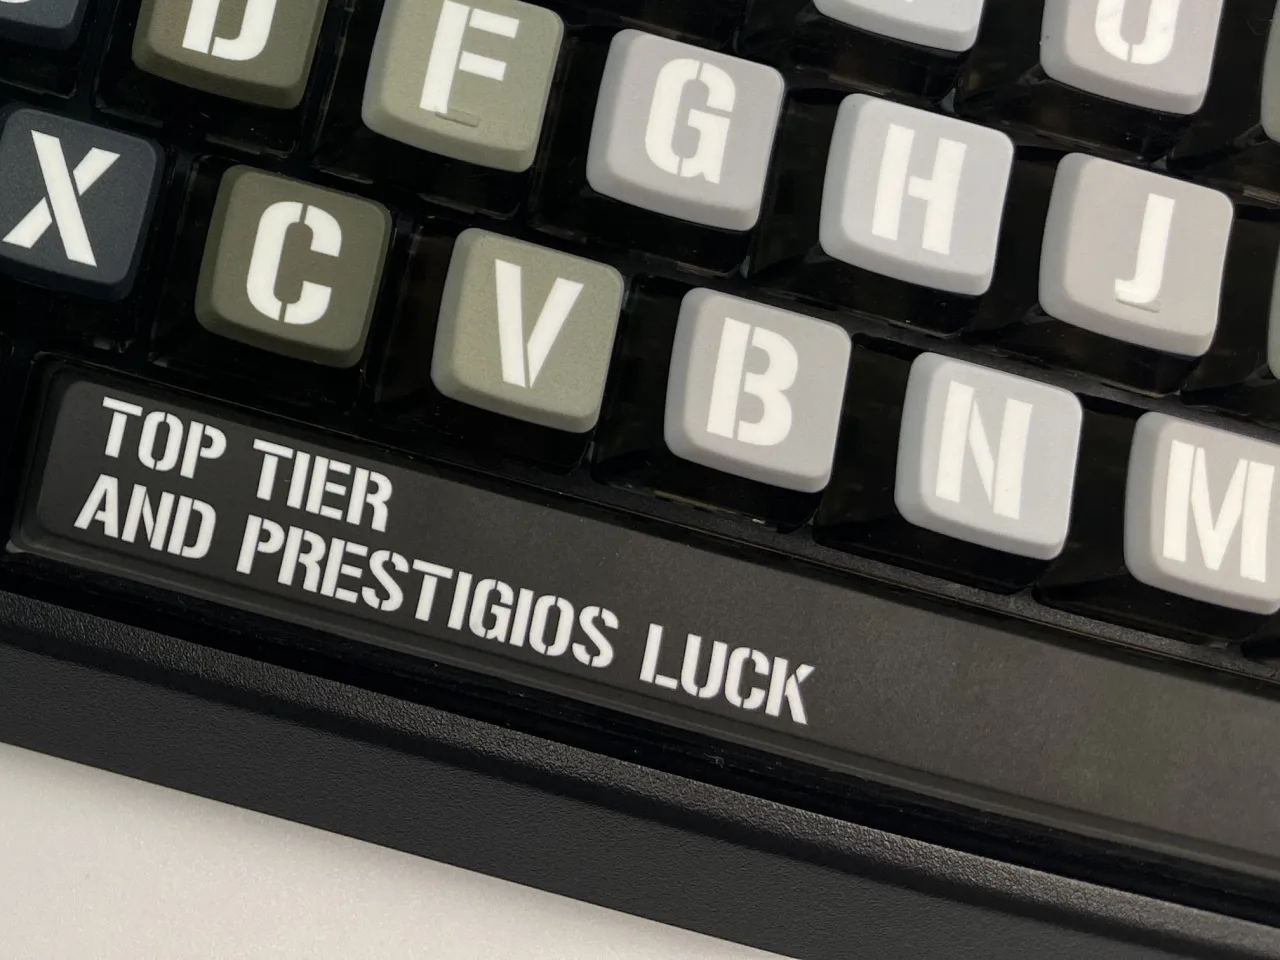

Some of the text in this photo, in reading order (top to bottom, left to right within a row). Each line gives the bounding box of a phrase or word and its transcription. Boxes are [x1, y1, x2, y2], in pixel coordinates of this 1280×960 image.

[419, 0, 520, 115] F
[644, 58, 737, 184] G
[3, 129, 120, 268] X
[871, 123, 968, 255] H
[1114, 193, 1177, 305] J
[246, 200, 343, 326] C
[494, 258, 584, 389] V
[706, 317, 799, 447] B
[102, 396, 394, 533] TOP TIER
[935, 380, 1033, 520] N
[1162, 439, 1276, 583] M
[73, 473, 816, 726] AND PRESTIGIOS LUCK
